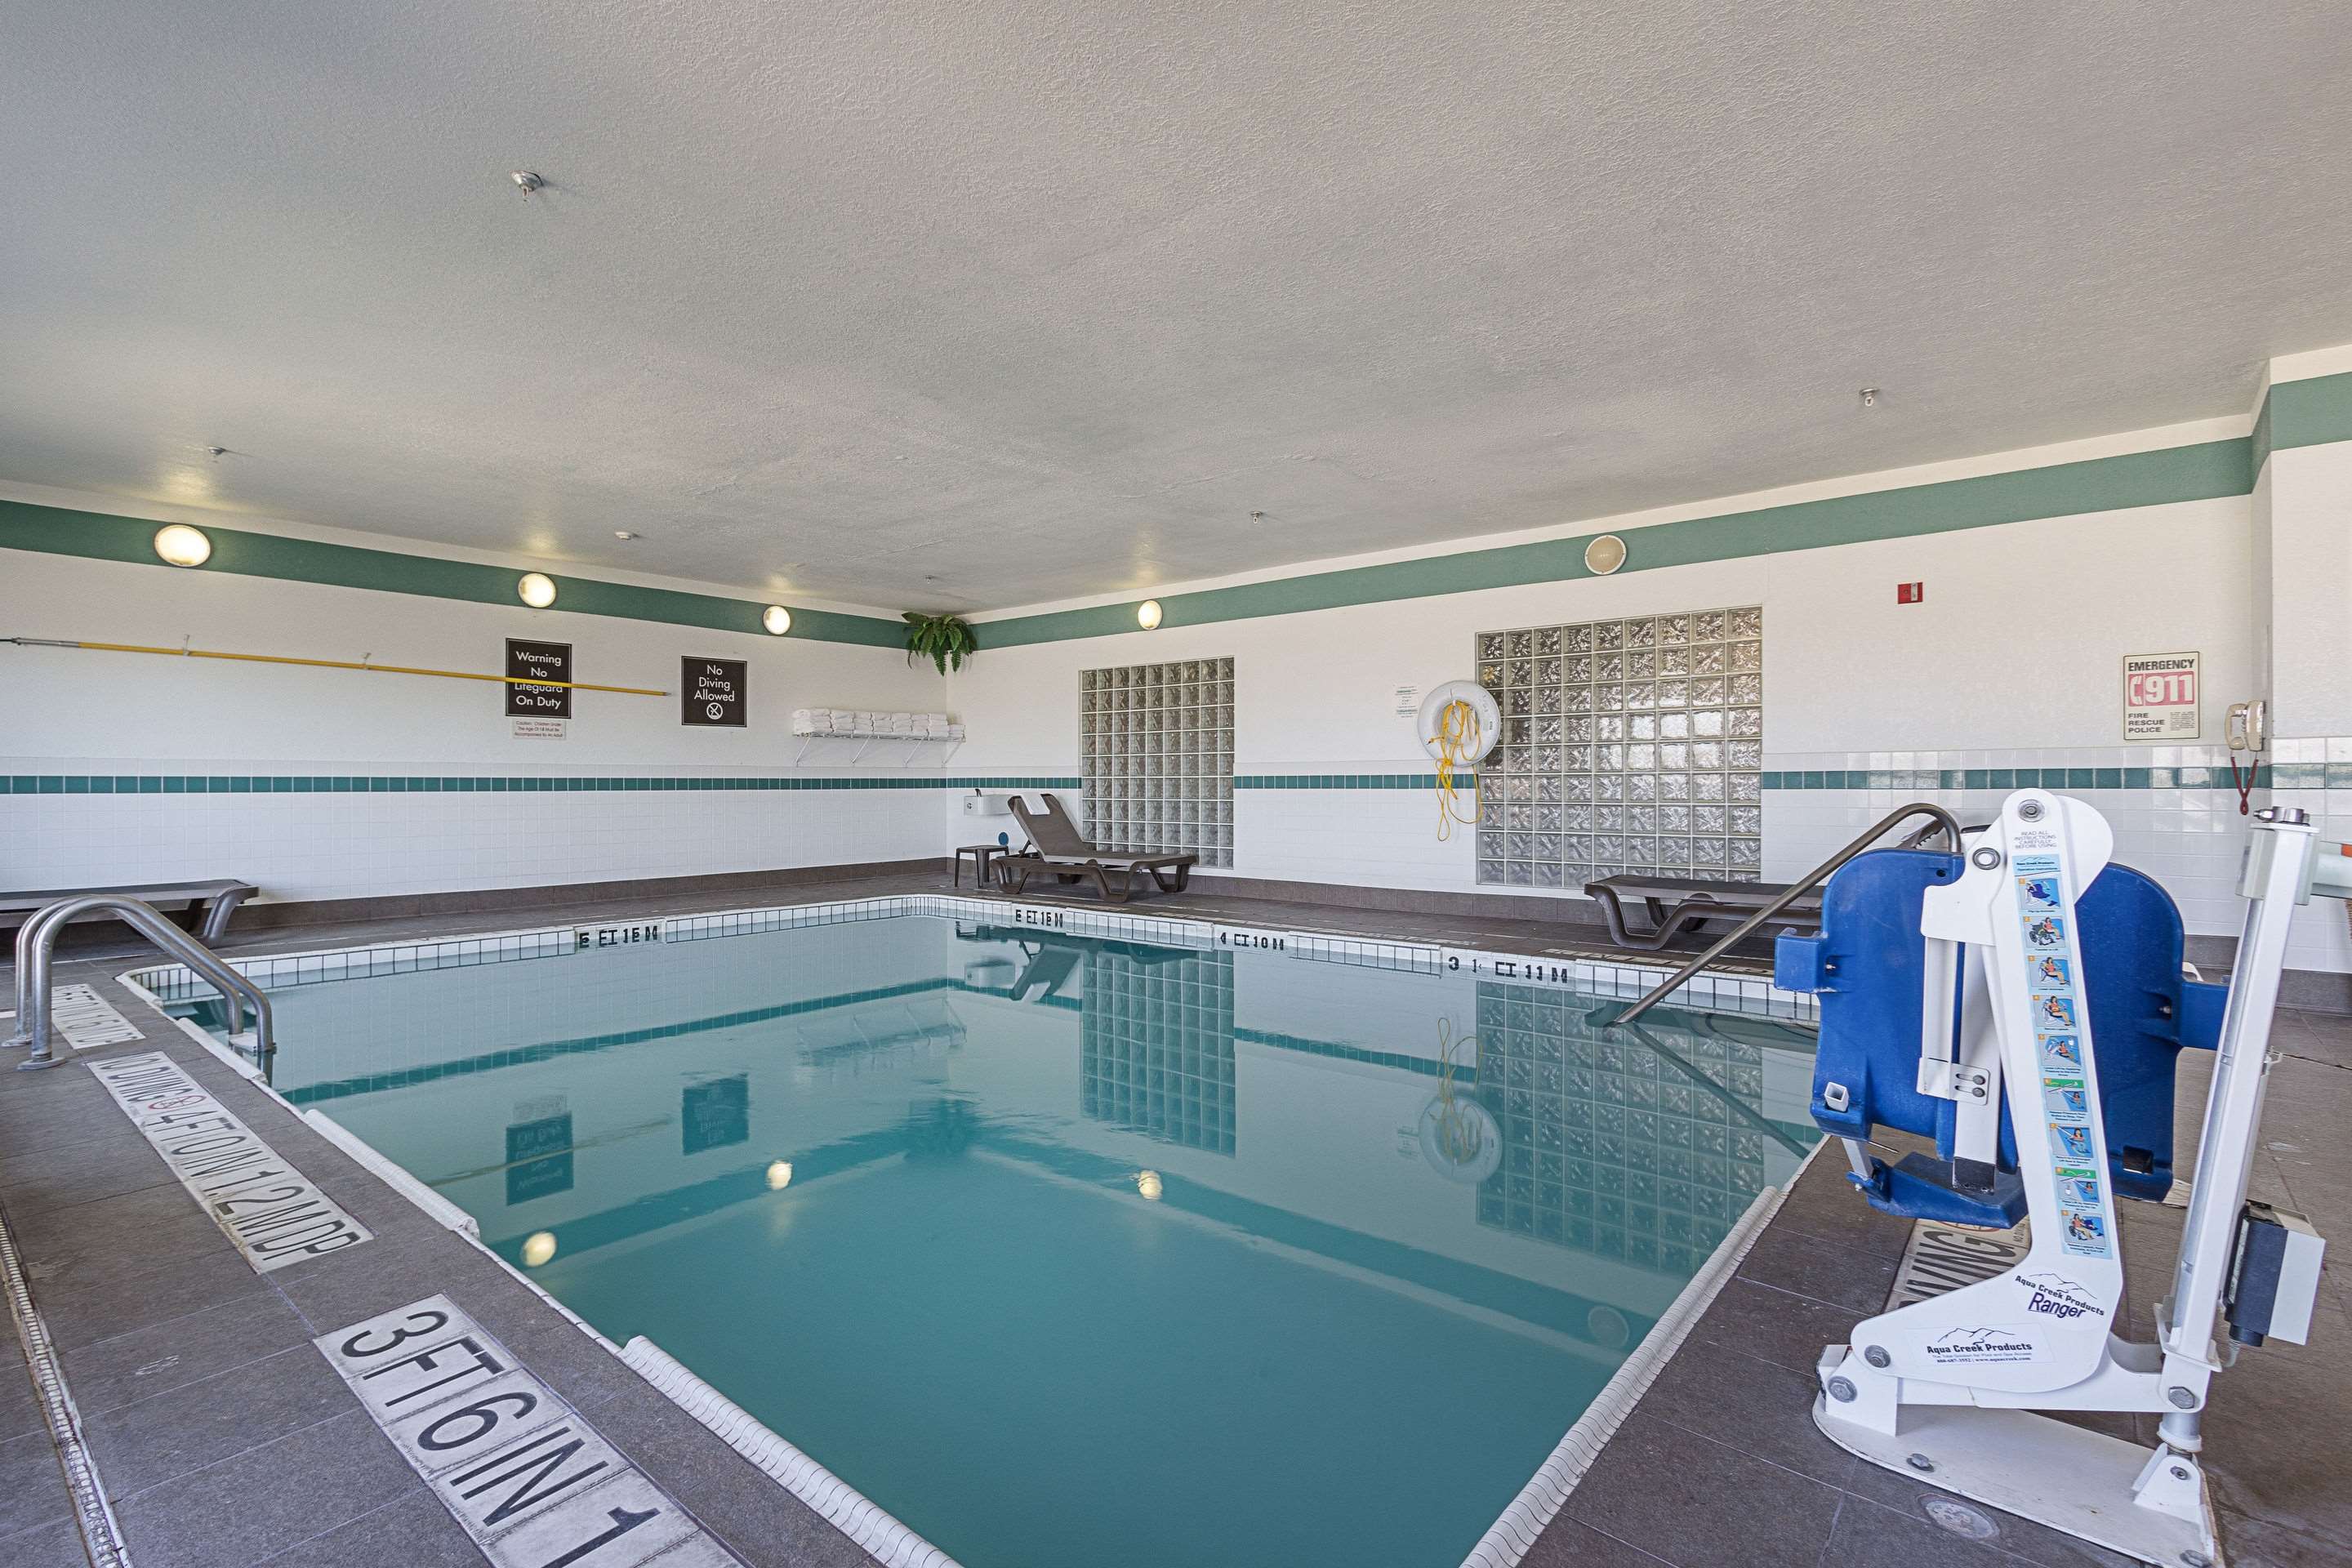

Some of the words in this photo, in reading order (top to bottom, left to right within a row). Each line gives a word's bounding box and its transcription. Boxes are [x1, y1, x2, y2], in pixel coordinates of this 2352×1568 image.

[516, 651, 562, 666] Warning
[707, 664, 723, 675] No
[2128, 658, 2195, 671] EMERGENCY
[531, 667, 547, 677] No
[699, 676, 730, 692] Diving
[694, 688, 735, 702] Allowed
[2145, 675, 2194, 703] 911
[516, 695, 533, 706] On
[537, 697, 561, 710] Duty
[107, 1066, 194, 1102] DIVING
[146, 1110, 218, 1126] 4
[154, 1117, 237, 1142] FT
[180, 1147, 270, 1177] IN
[232, 1200, 331, 1238] M
[252, 1219, 361, 1261] DP
[2015, 1275, 2036, 1289] Aqua
[2038, 1284, 2064, 1299] Creek
[2065, 1294, 2105, 1316] Products
[2028, 1292, 2087, 1318] Ranger
[341, 1311, 448, 1357] 3
[1927, 1346, 1951, 1355] Aqua
[1953, 1344, 1984, 1352] Creek
[1985, 1343, 2033, 1352] Products
[363, 1335, 505, 1407] FT
[417, 1392, 537, 1451] 6
[449, 1426, 609, 1527] IN
